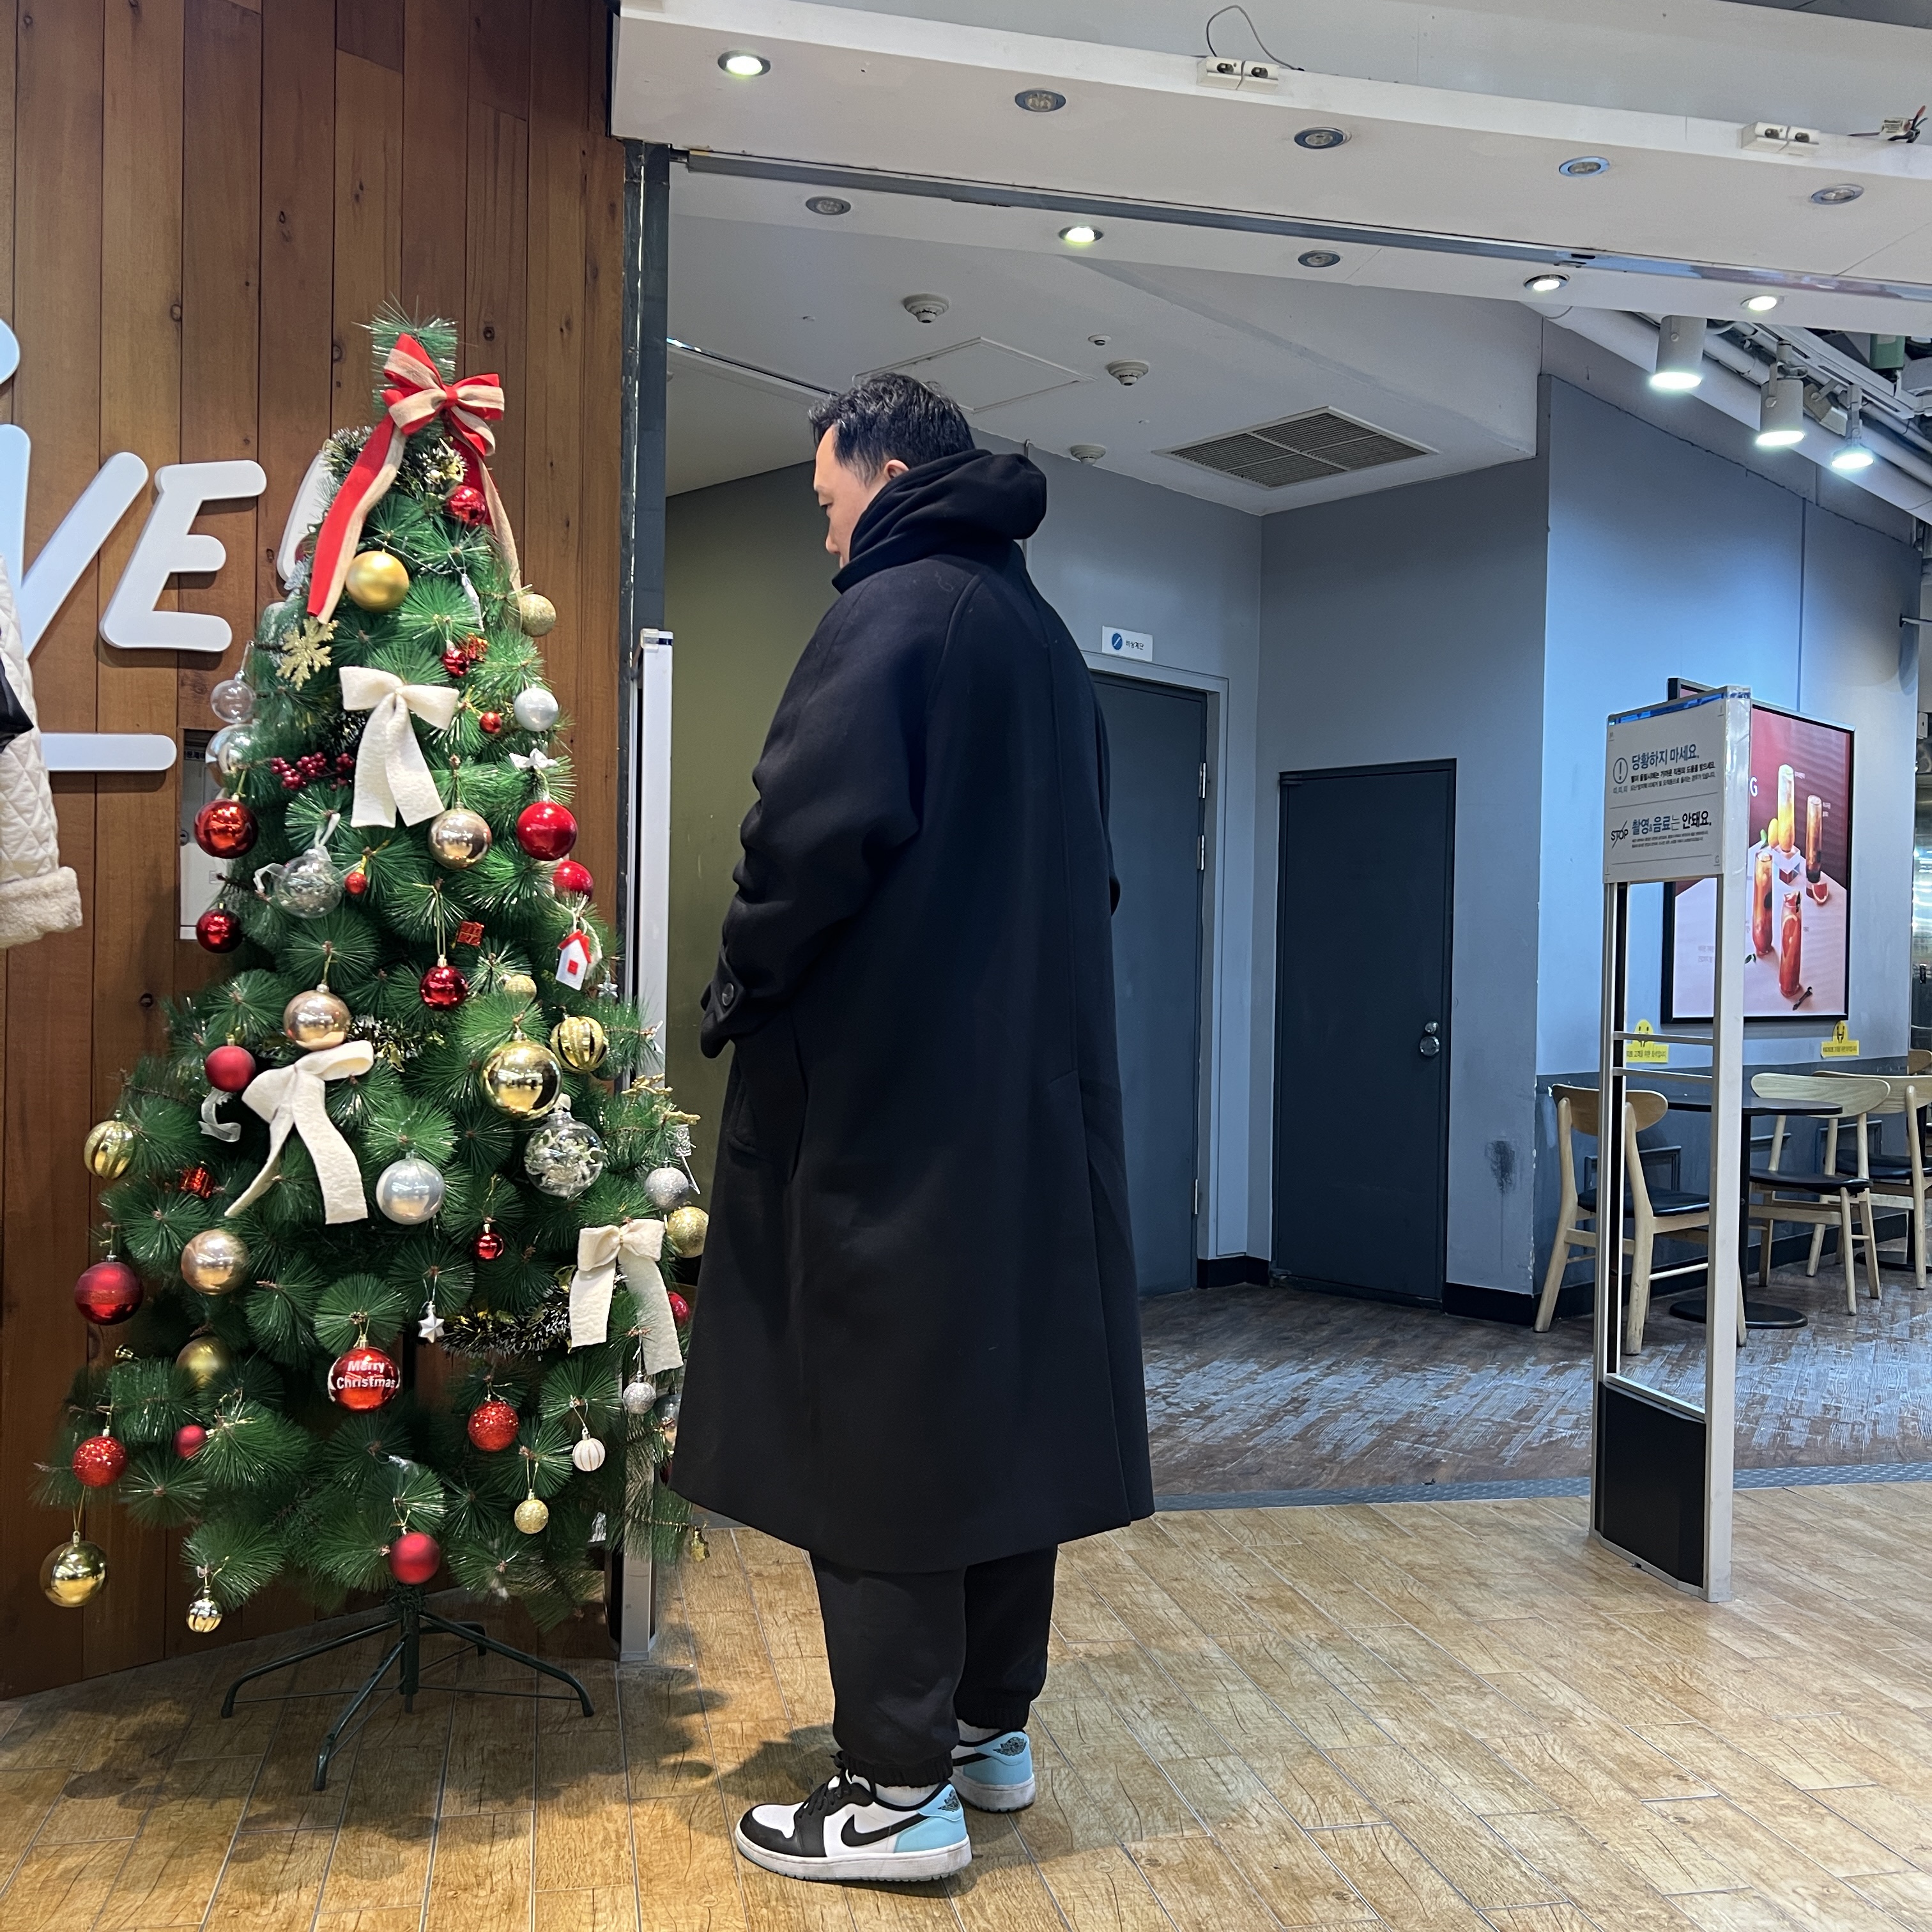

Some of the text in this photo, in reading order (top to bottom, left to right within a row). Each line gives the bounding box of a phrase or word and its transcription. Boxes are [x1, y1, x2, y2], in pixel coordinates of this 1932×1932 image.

[1632, 744, 1699, 770] 당황하지 마세요.
[1682, 810, 1712, 829] 안돼요.
[1611, 829, 1629, 841] STOP
[348, 1360, 385, 1373] Merry
[336, 1376, 396, 1390] Christmas
